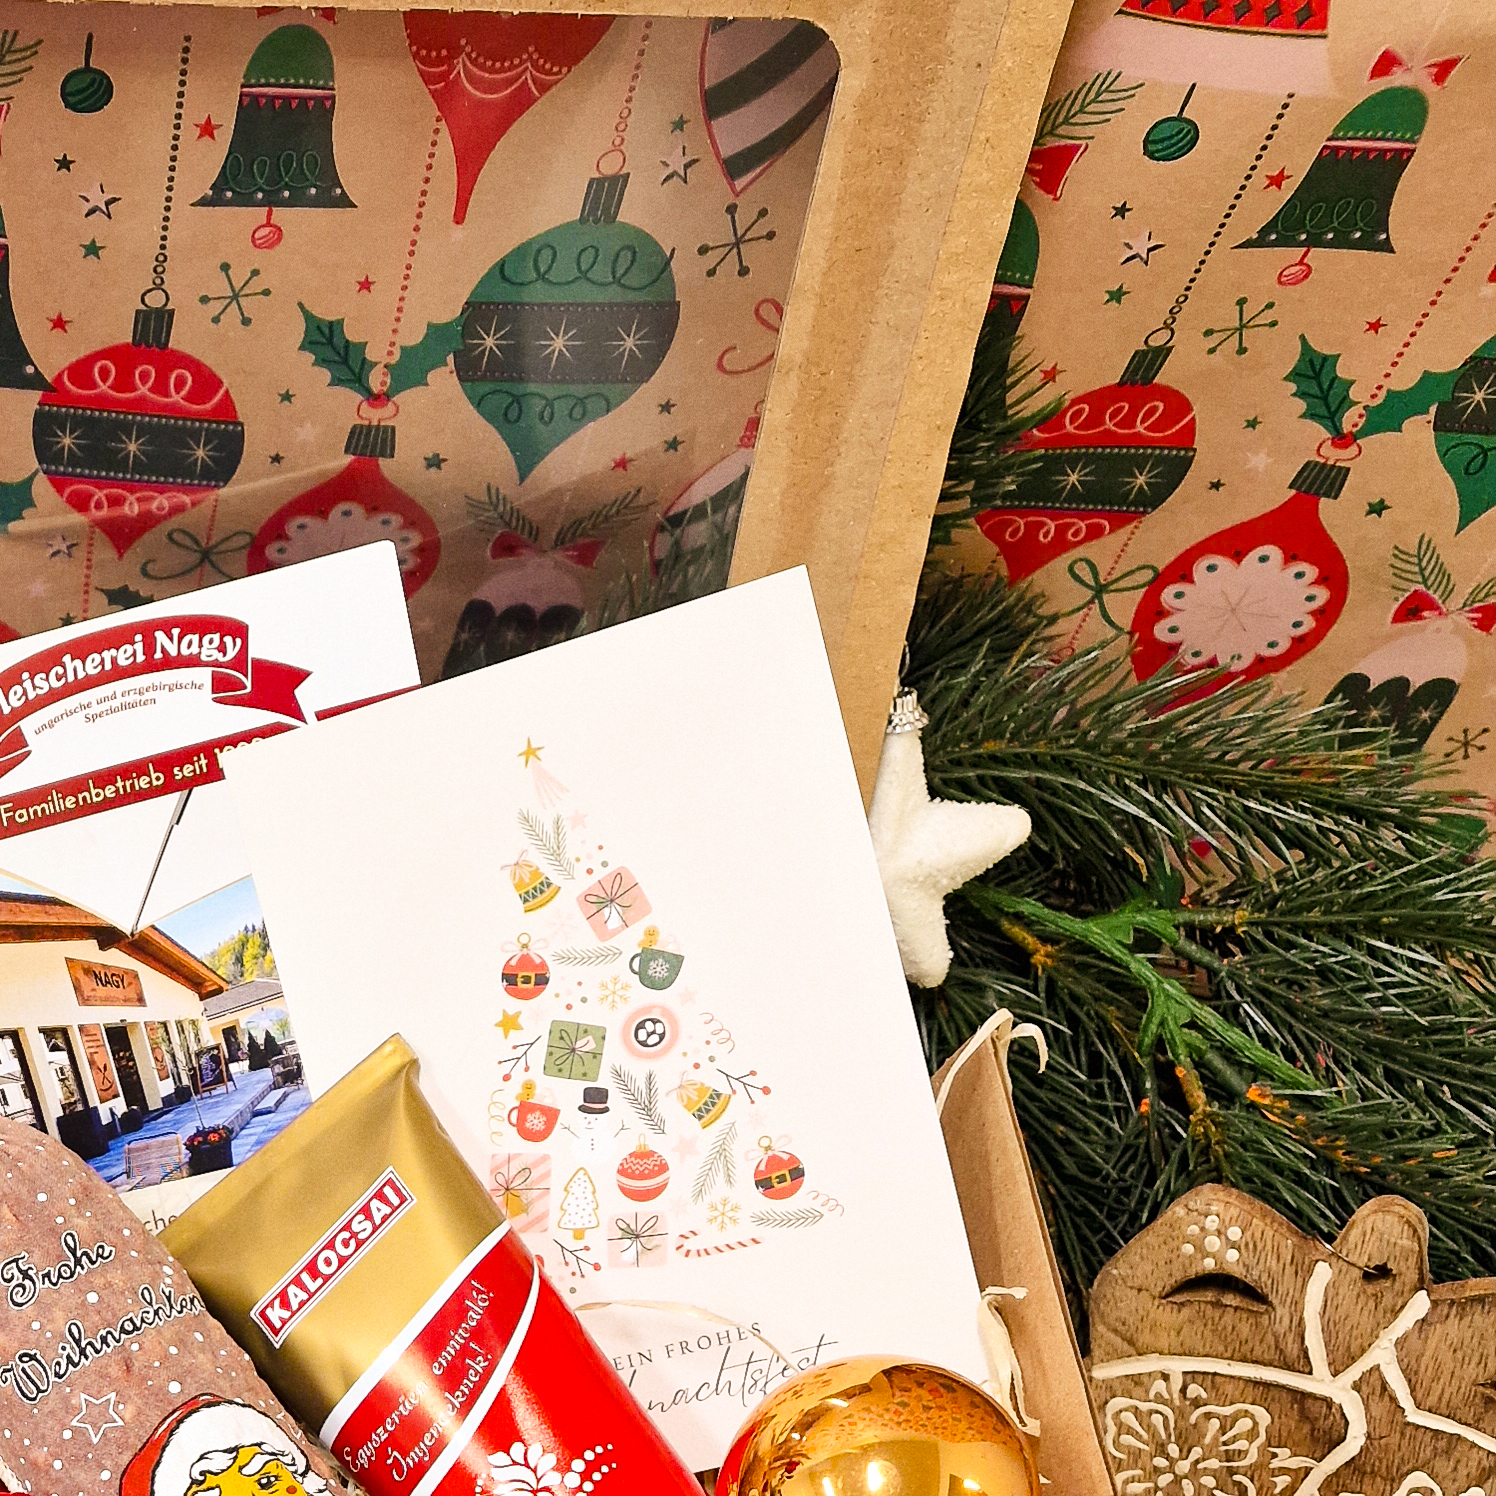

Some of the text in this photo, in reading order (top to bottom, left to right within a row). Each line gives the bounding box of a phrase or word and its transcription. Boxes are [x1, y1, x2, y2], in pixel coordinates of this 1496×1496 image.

[153, 626, 243, 662] Nagy
[34, 679, 205, 735] ungarische und erzgebirgische
[84, 696, 157, 724] Spezialitäten
[0, 763, 165, 828] Familienbetrieb
[173, 752, 208, 780] seit
[92, 969, 126, 989] NAGY
[0, 1230, 115, 1309] Frohe
[265, 1179, 403, 1331] KALOCSAI
[0, 1283, 205, 1403] Weihnachten
[432, 1279, 495, 1376] ennivaló!
[612, 1322, 762, 1372] EIN FROHES
